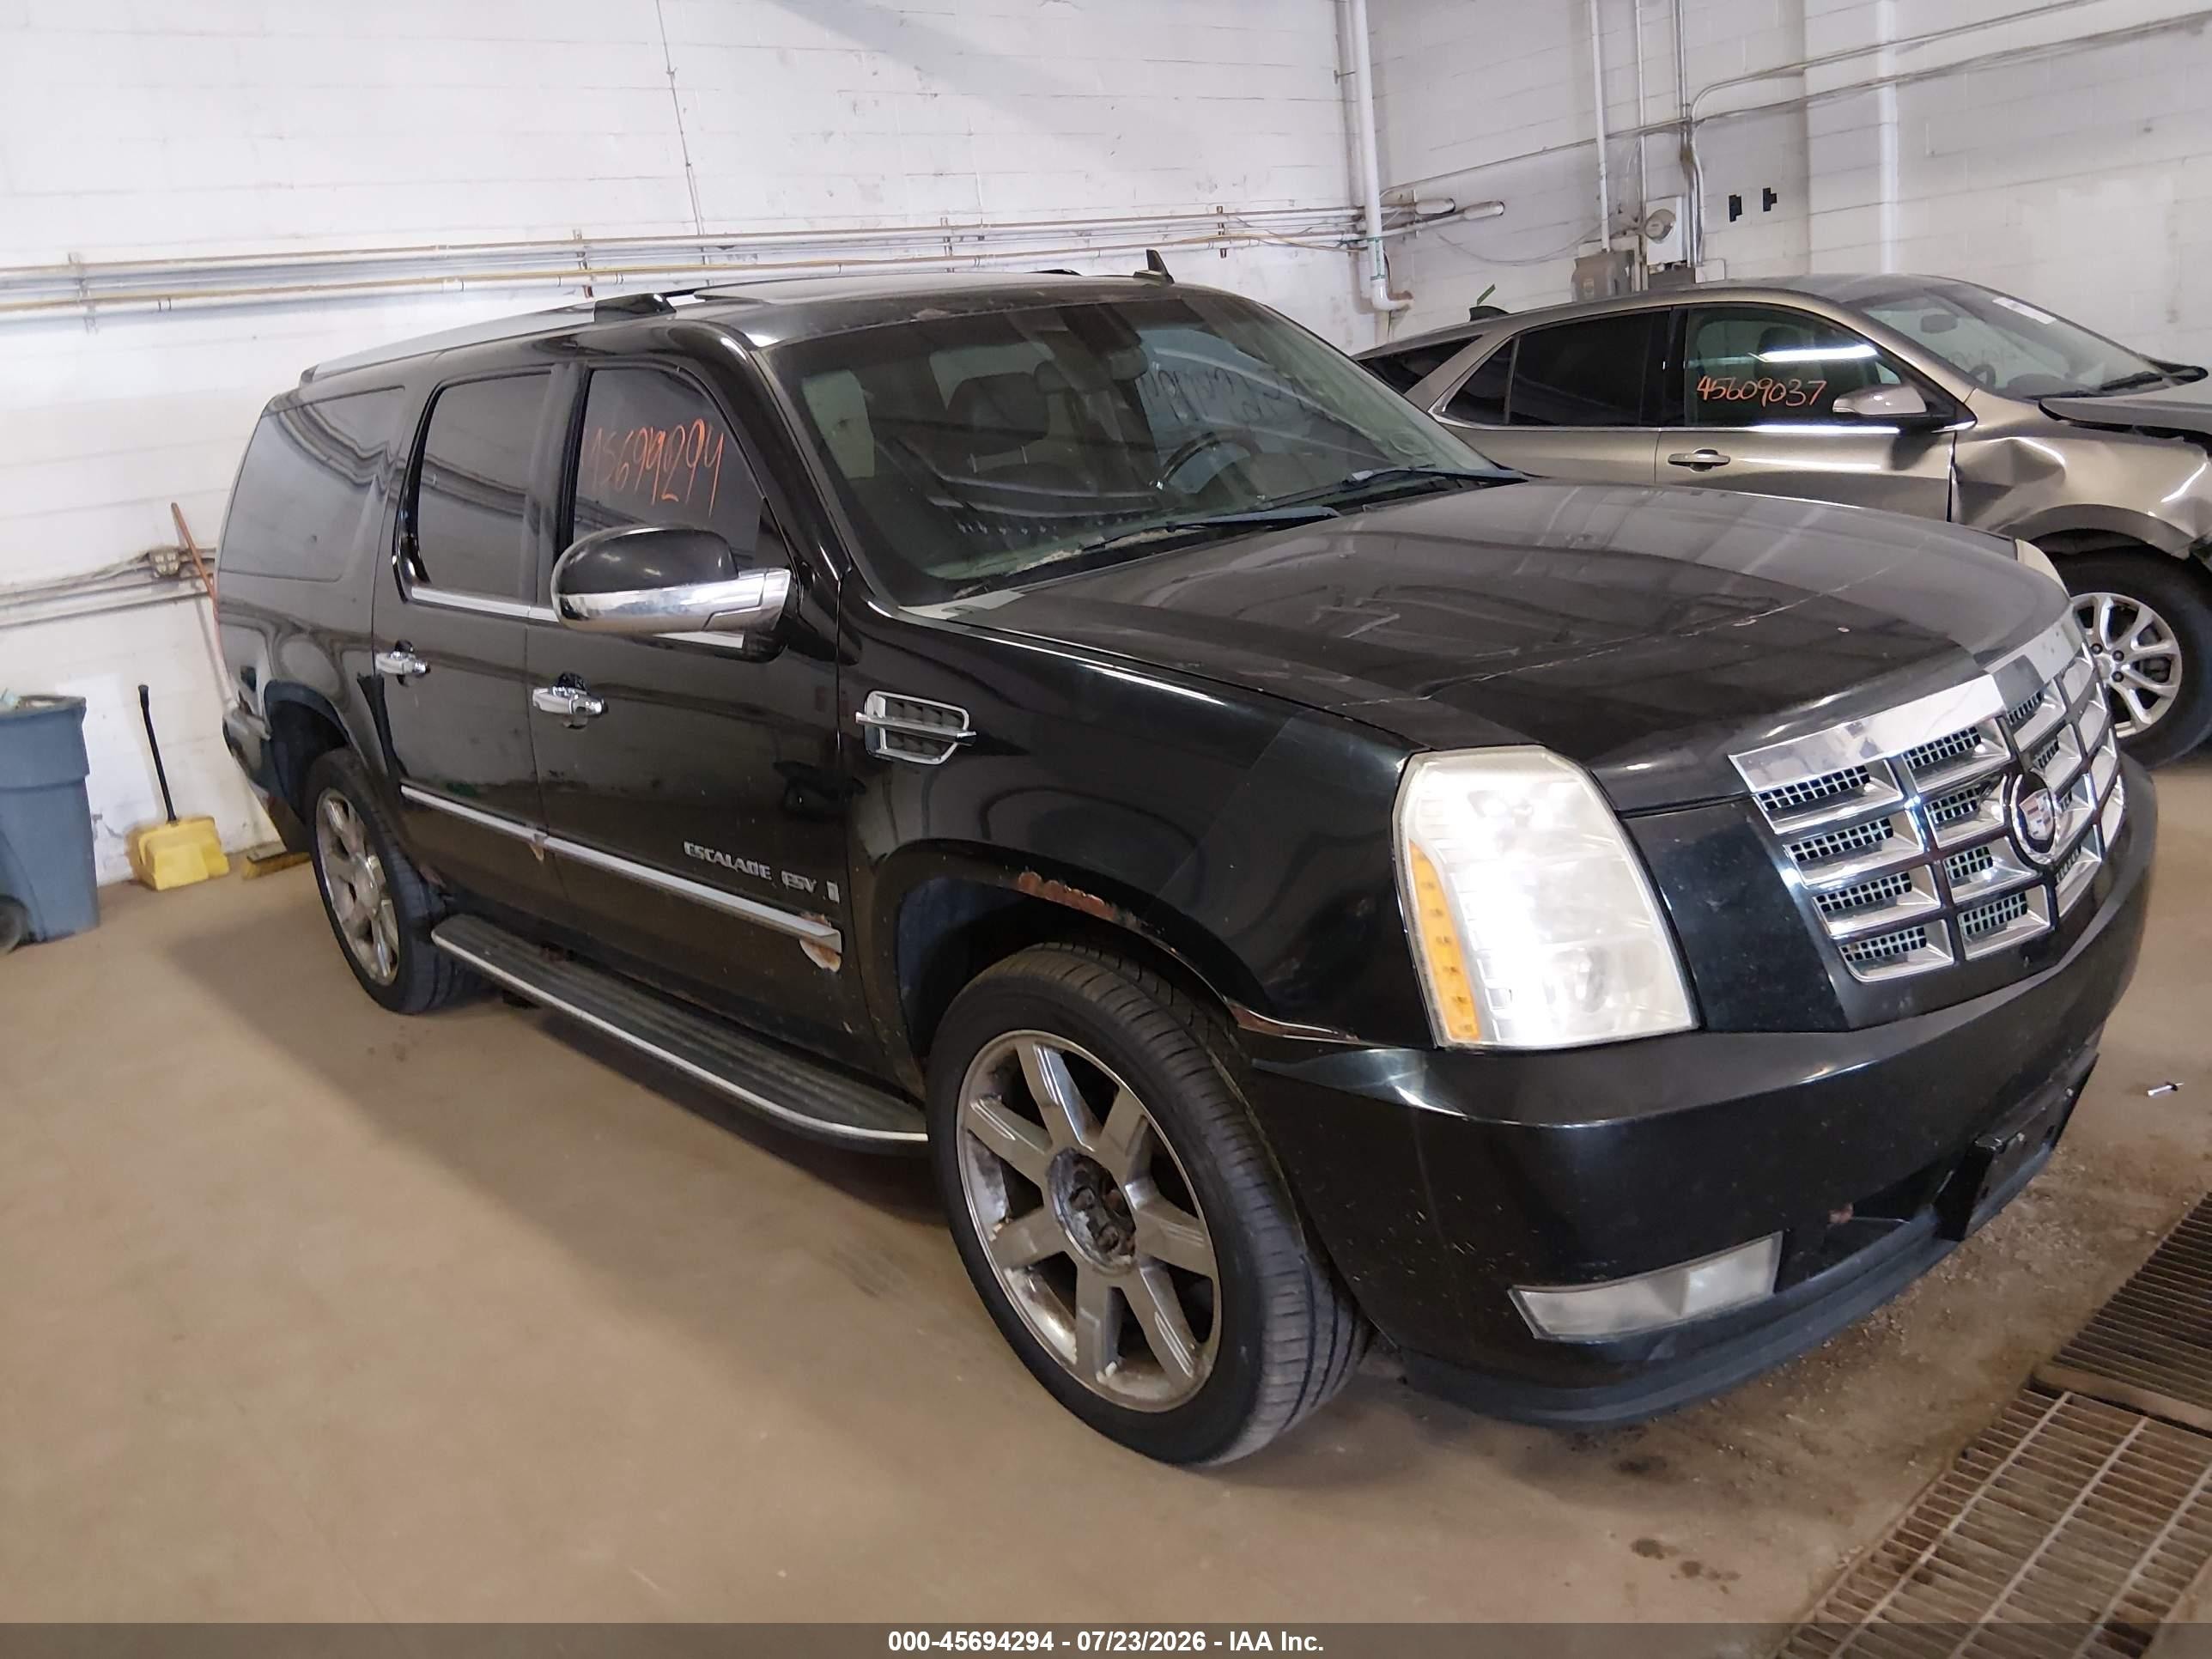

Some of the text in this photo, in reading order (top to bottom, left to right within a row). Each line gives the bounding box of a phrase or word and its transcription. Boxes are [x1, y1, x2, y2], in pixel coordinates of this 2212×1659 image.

[1697, 375, 1827, 408] 45609037
[684, 841, 817, 894] ESCALADE ESV
